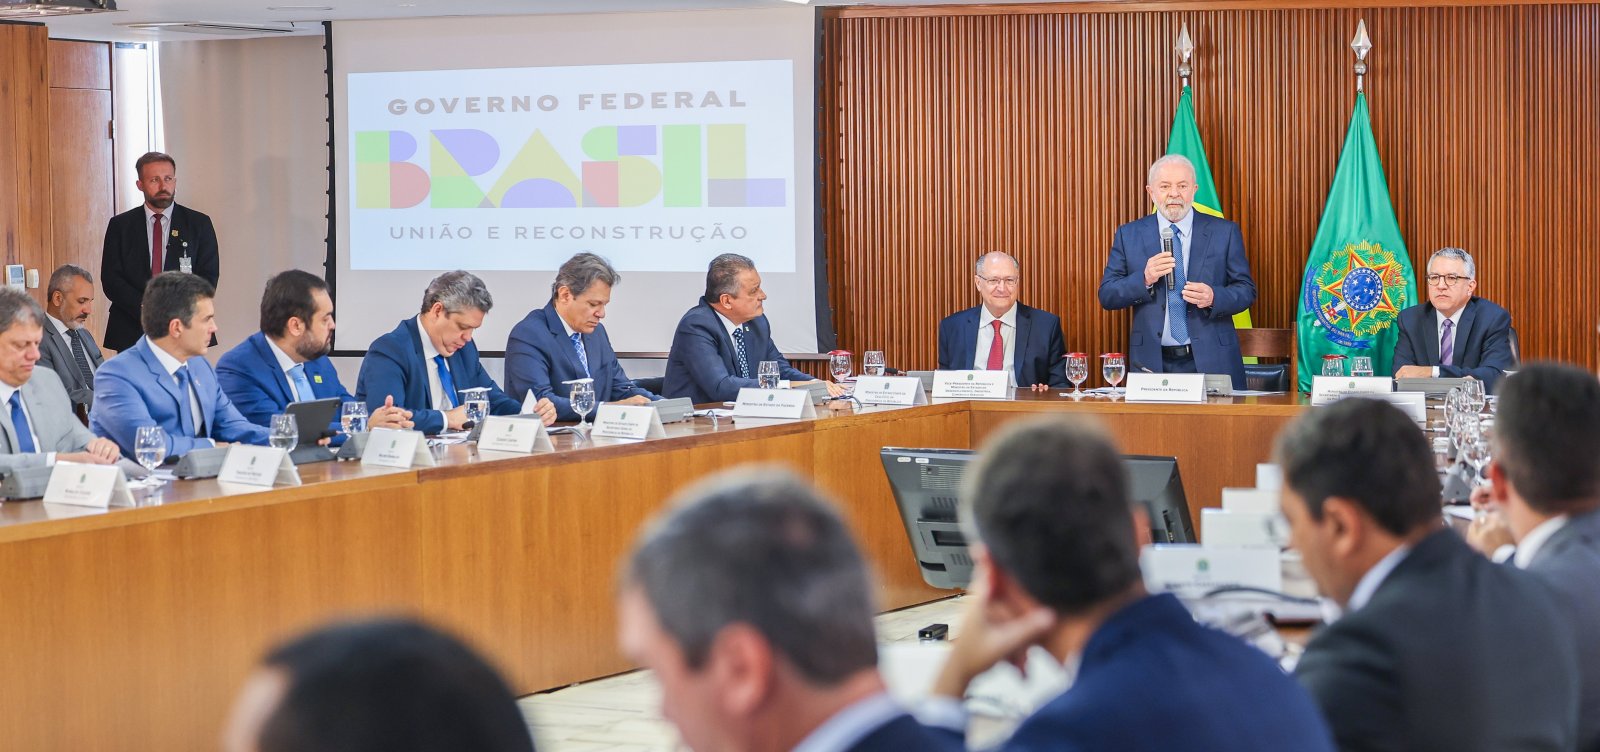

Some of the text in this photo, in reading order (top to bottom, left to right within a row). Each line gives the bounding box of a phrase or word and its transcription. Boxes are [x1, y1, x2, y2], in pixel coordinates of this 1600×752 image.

[387, 90, 746, 115] GOVERNO FEDERAL
[355, 123, 786, 209] BRASIL
[389, 222, 748, 243] UNIÃO E RECONSTRUÇÃO
